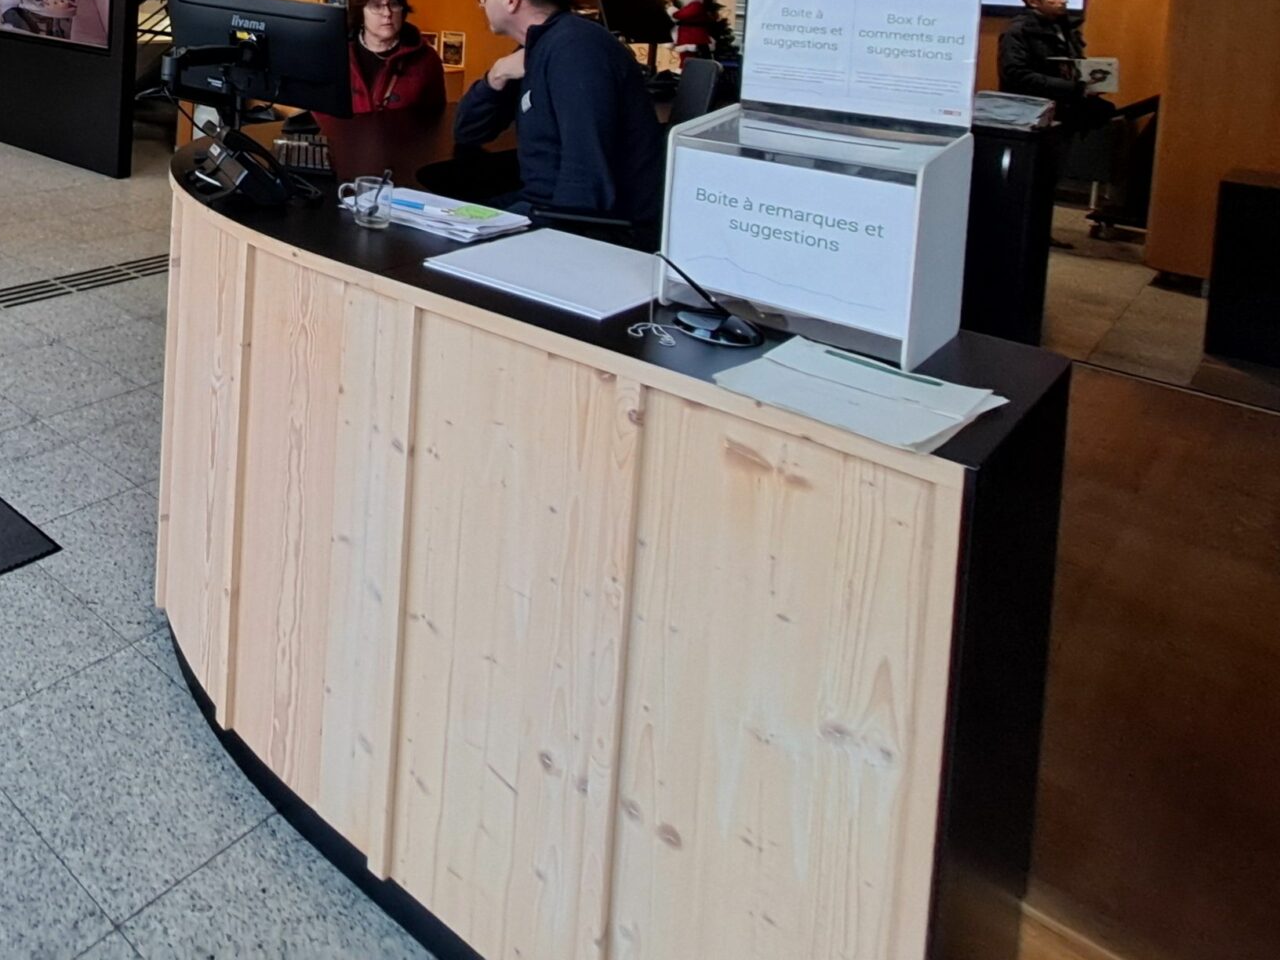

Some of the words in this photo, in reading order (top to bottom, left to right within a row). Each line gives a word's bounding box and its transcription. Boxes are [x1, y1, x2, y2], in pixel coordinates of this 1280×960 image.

[886, 13, 913, 25] Box
[916, 15, 937, 26] for
[761, 22, 828, 35] remarques
[830, 26, 843, 36] et
[763, 37, 839, 51] suggestions
[858, 30, 934, 43] comments
[937, 34, 966, 46] and
[866, 45, 953, 61] suggestions
[742, 196, 754, 211] à
[758, 201, 859, 233] remarques
[864, 224, 886, 239] et
[728, 218, 841, 253] suggestions
